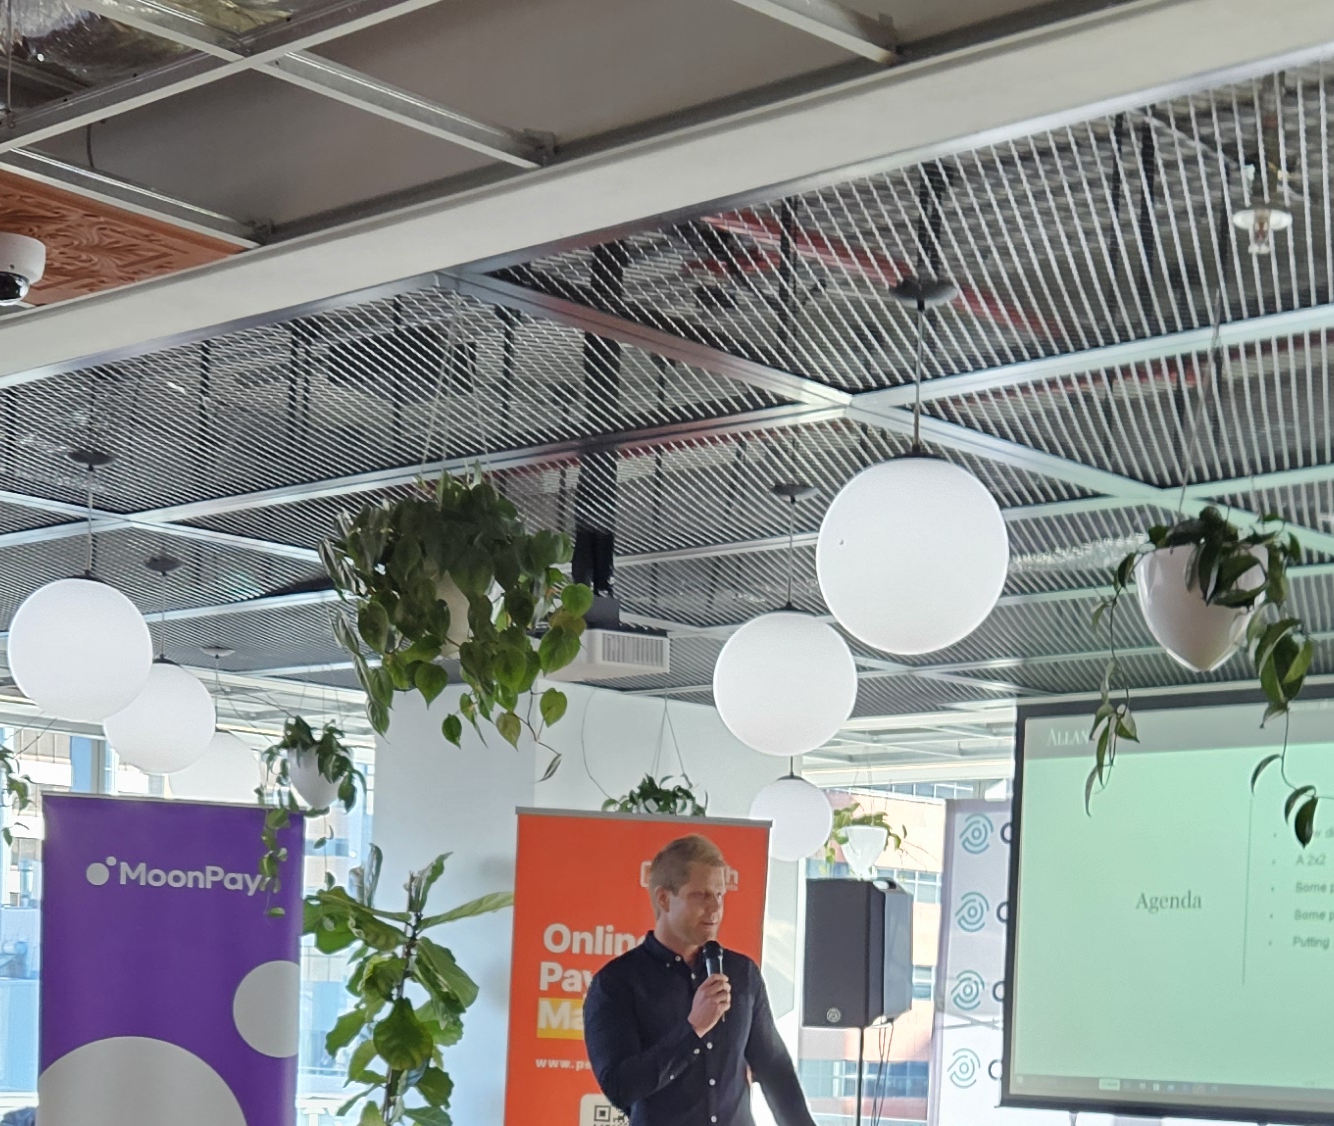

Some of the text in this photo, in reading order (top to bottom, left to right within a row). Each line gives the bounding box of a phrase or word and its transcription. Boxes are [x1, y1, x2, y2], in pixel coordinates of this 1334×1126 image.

[1296, 855, 1304, 866] A
[119, 861, 263, 896] MoonPay
[1295, 882, 1327, 893] Some
[1135, 889, 1203, 914] Agenda
[1294, 909, 1326, 921] Some
[1292, 936, 1330, 950] Putting
[538, 998, 585, 1031] Ma
